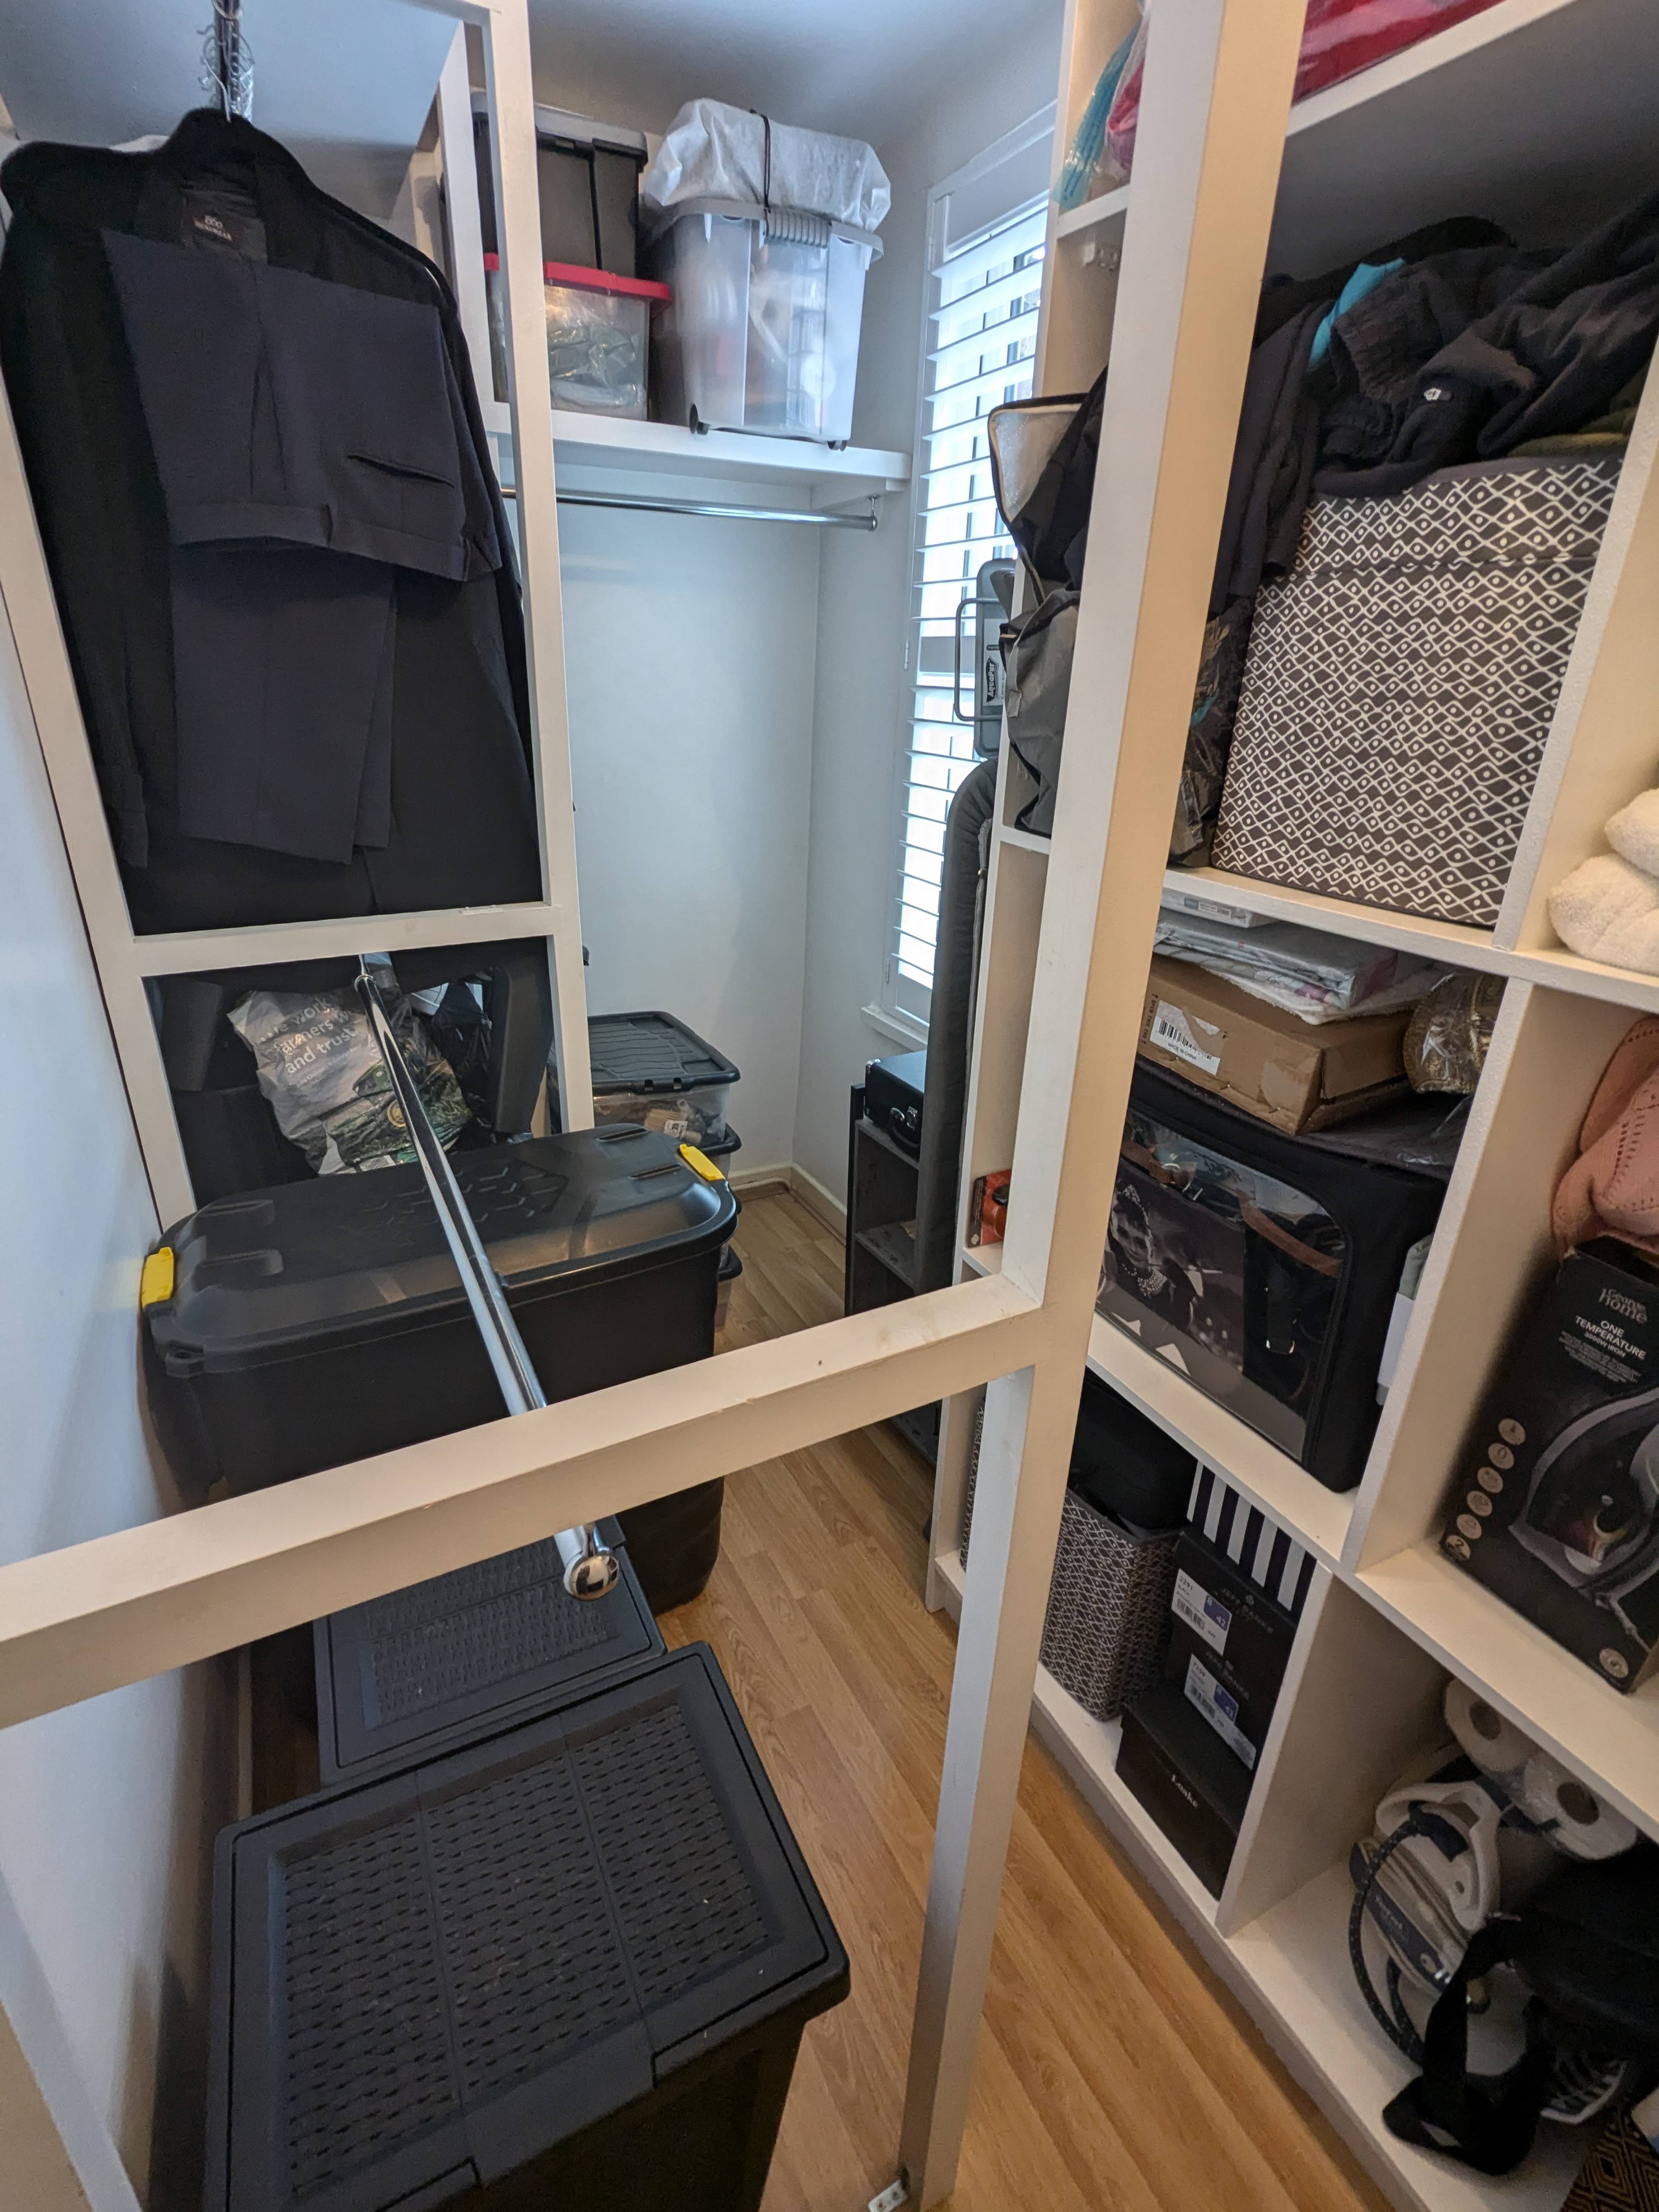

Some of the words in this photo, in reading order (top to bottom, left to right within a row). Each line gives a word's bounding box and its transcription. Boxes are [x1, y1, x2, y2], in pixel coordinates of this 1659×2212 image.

[273, 1020, 334, 1055] farmers
[285, 1046, 316, 1073] and
[1168, 1042, 1179, 1052] MADE
[1184, 1051, 1197, 1061] CHINA
[1576, 1315, 1646, 1360] TEMPERATURE
[1601, 1320, 1624, 1338] ONE
[1216, 1616, 1226, 1627] 42
